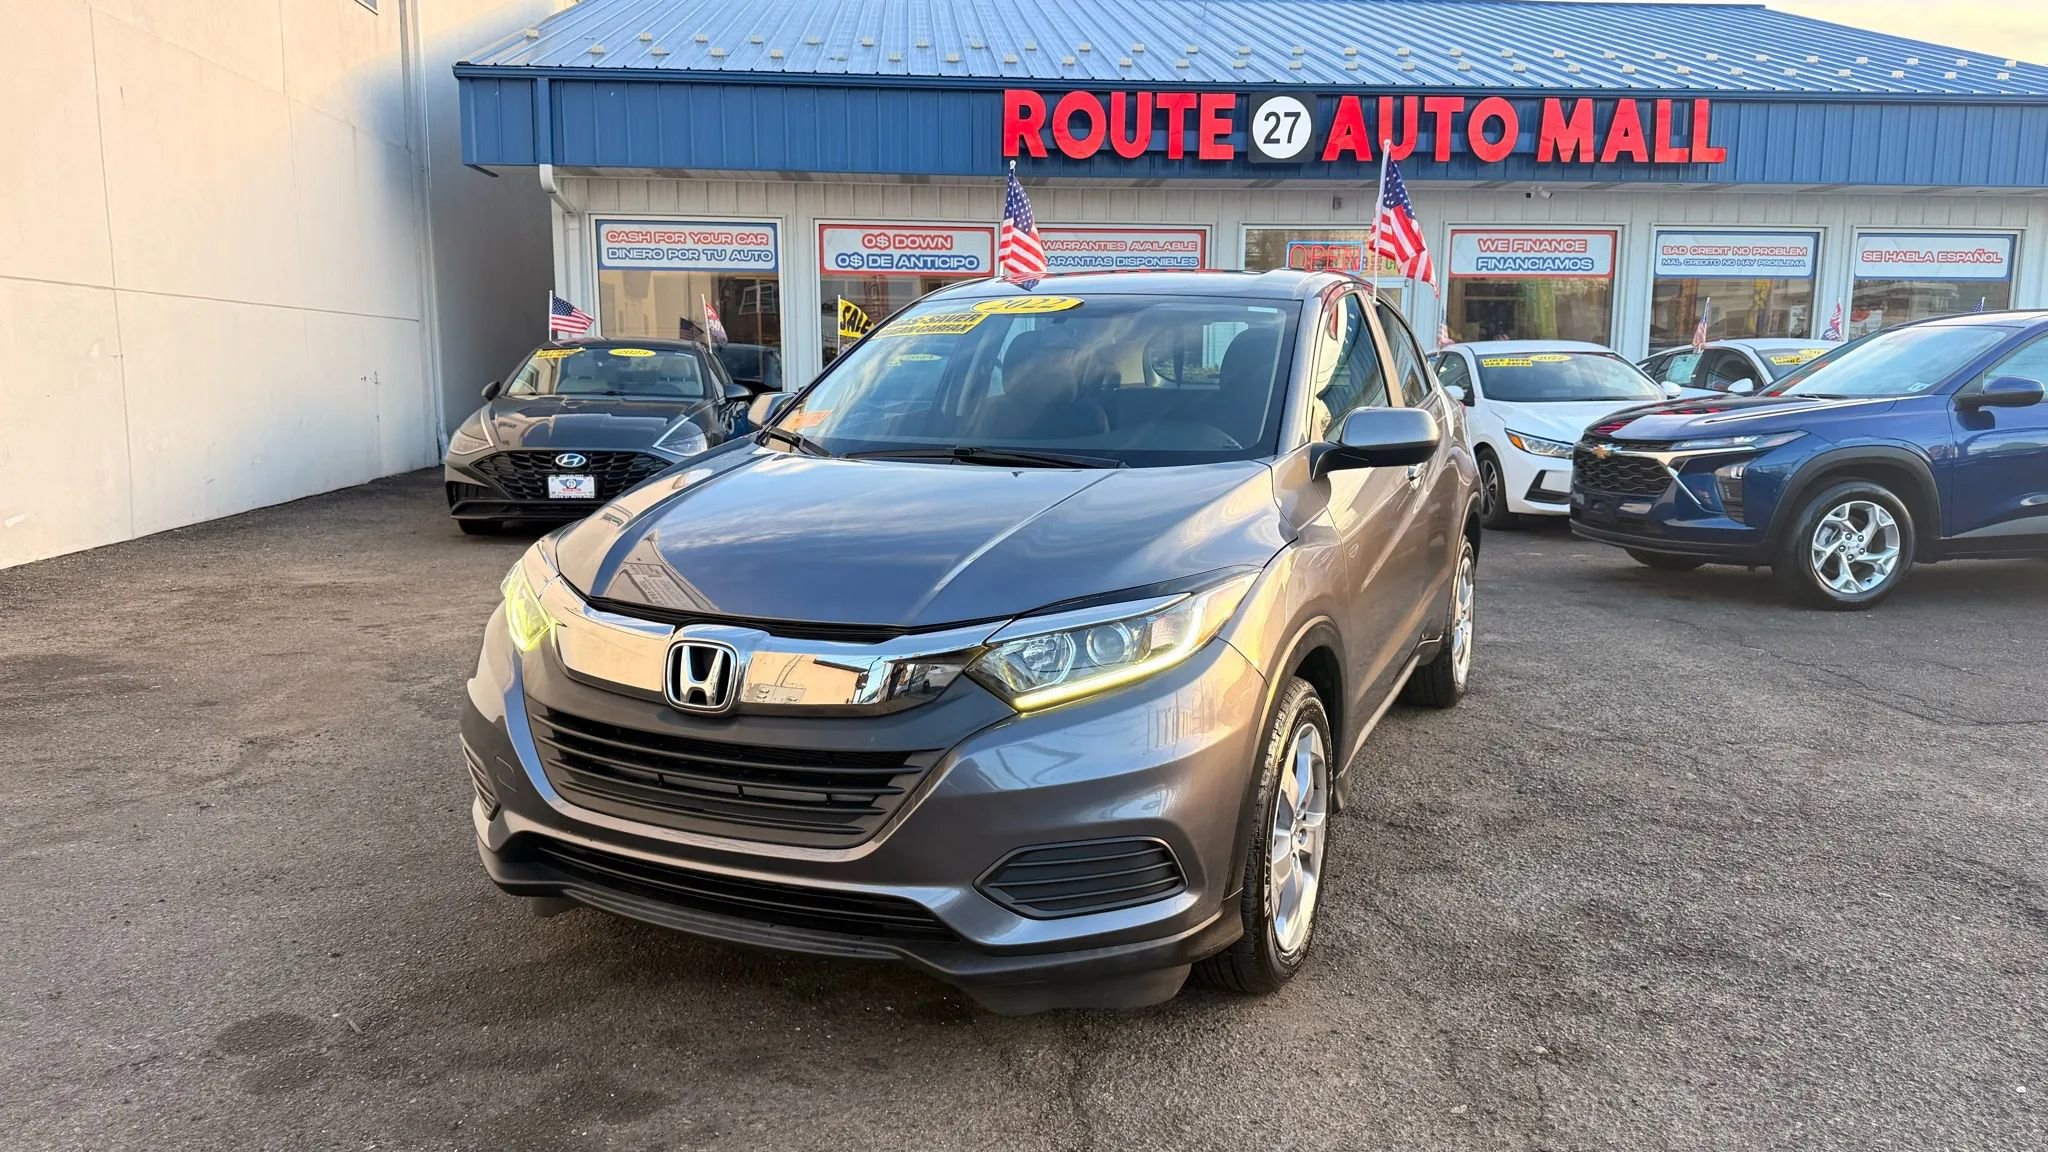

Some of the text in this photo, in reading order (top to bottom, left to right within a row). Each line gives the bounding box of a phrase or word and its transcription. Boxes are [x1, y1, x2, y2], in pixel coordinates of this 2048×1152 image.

[1003, 89, 1728, 164] ROUTE 27 AUTO MALL
[606, 230, 769, 246] CASH FOR YOUR CAR
[892, 234, 953, 250] DOWN
[1041, 240, 1198, 252] WARRANTIES AVAILABLE
[1478, 238, 1588, 254] WE FINANCE
[607, 247, 773, 262] DINERO POR TU AUTO
[1289, 244, 1361, 273] OPEN
[1662, 245, 1807, 257] BAD CREDIT NO PROBLEM
[1862, 248, 2003, 264] SE HABLA ESPAÑOL
[866, 253, 894, 269] DE
[896, 254, 980, 271] ANTICIPO
[1116, 256, 1200, 268] DISPONIBLES
[1476, 256, 1594, 272] FINANCIAMOS
[1662, 257, 1806, 268] MAL CREDITO NO HAY PROBLEMA
[986, 298, 1068, 311] 2022
